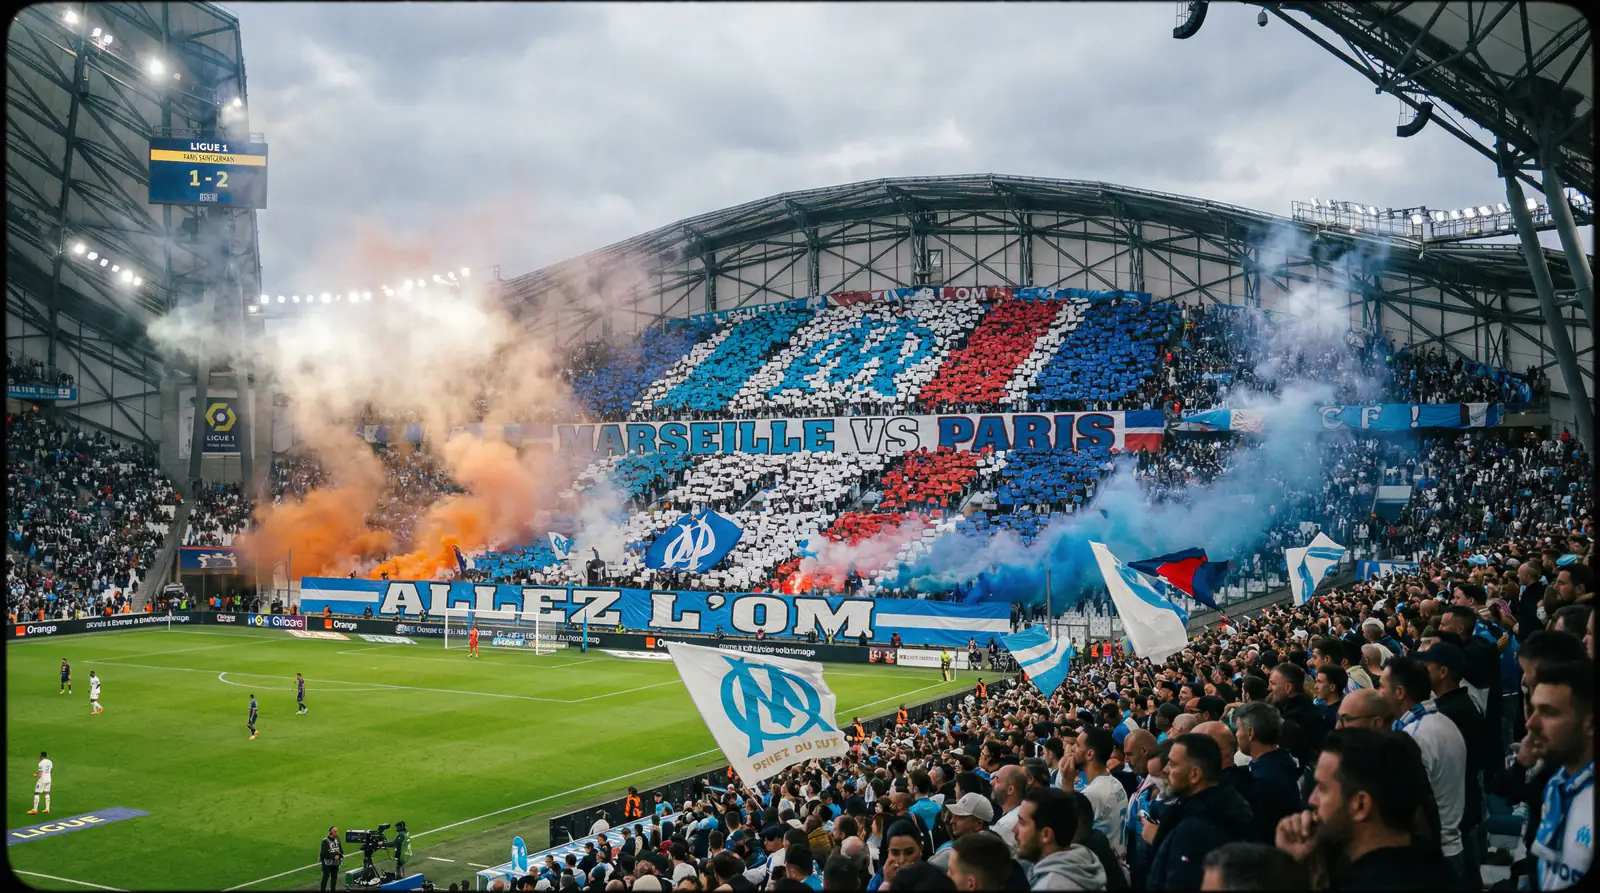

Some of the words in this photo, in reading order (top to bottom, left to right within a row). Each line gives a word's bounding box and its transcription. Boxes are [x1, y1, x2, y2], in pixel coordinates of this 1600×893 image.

[190, 142, 220, 152] LIGUE
[222, 144, 229, 152] 1
[189, 169, 201, 187] 1
[216, 171, 229, 188] 2
[557, 417, 835, 457] MARSEILLE
[849, 416, 920, 454] VS
[937, 411, 1116, 452] PARIS
[379, 581, 621, 627] ALLEZ
[648, 592, 875, 639] L'OM
[27, 624, 57, 635] Orange
[333, 620, 358, 631] Orange
[11, 815, 106, 839] LIGUE
